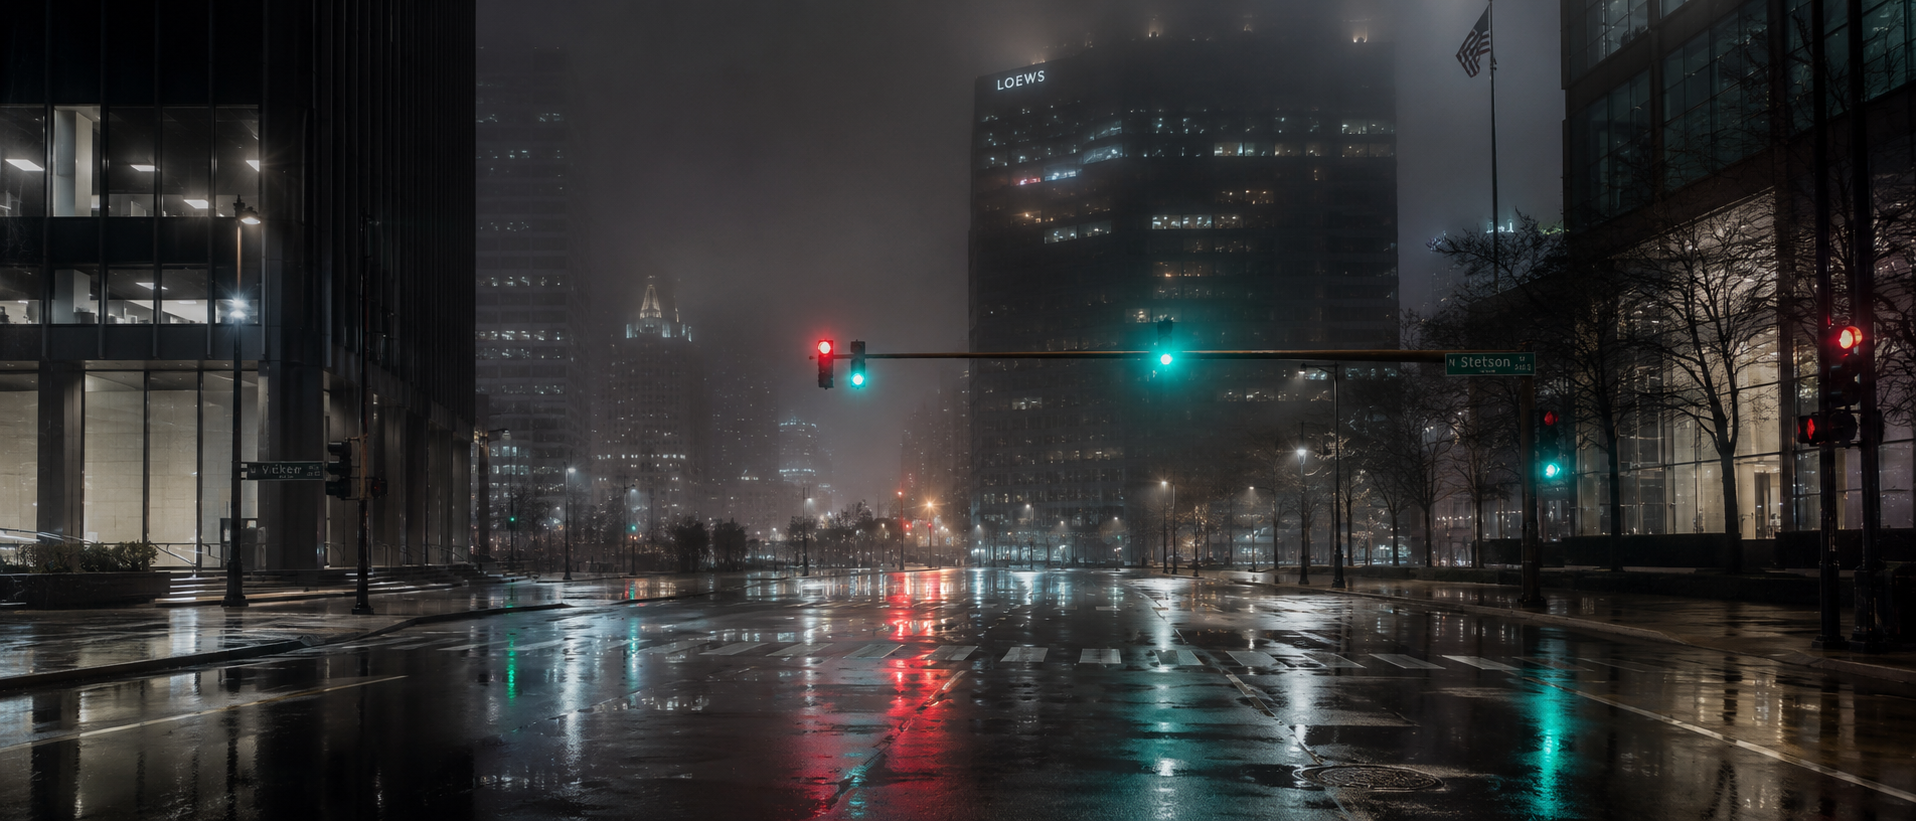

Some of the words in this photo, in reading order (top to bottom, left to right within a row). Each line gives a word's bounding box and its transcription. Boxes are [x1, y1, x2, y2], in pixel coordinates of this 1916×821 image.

[997, 70, 1045, 91] LOEWS
[1449, 358, 1455, 367] N
[1461, 356, 1511, 368] Stetson
